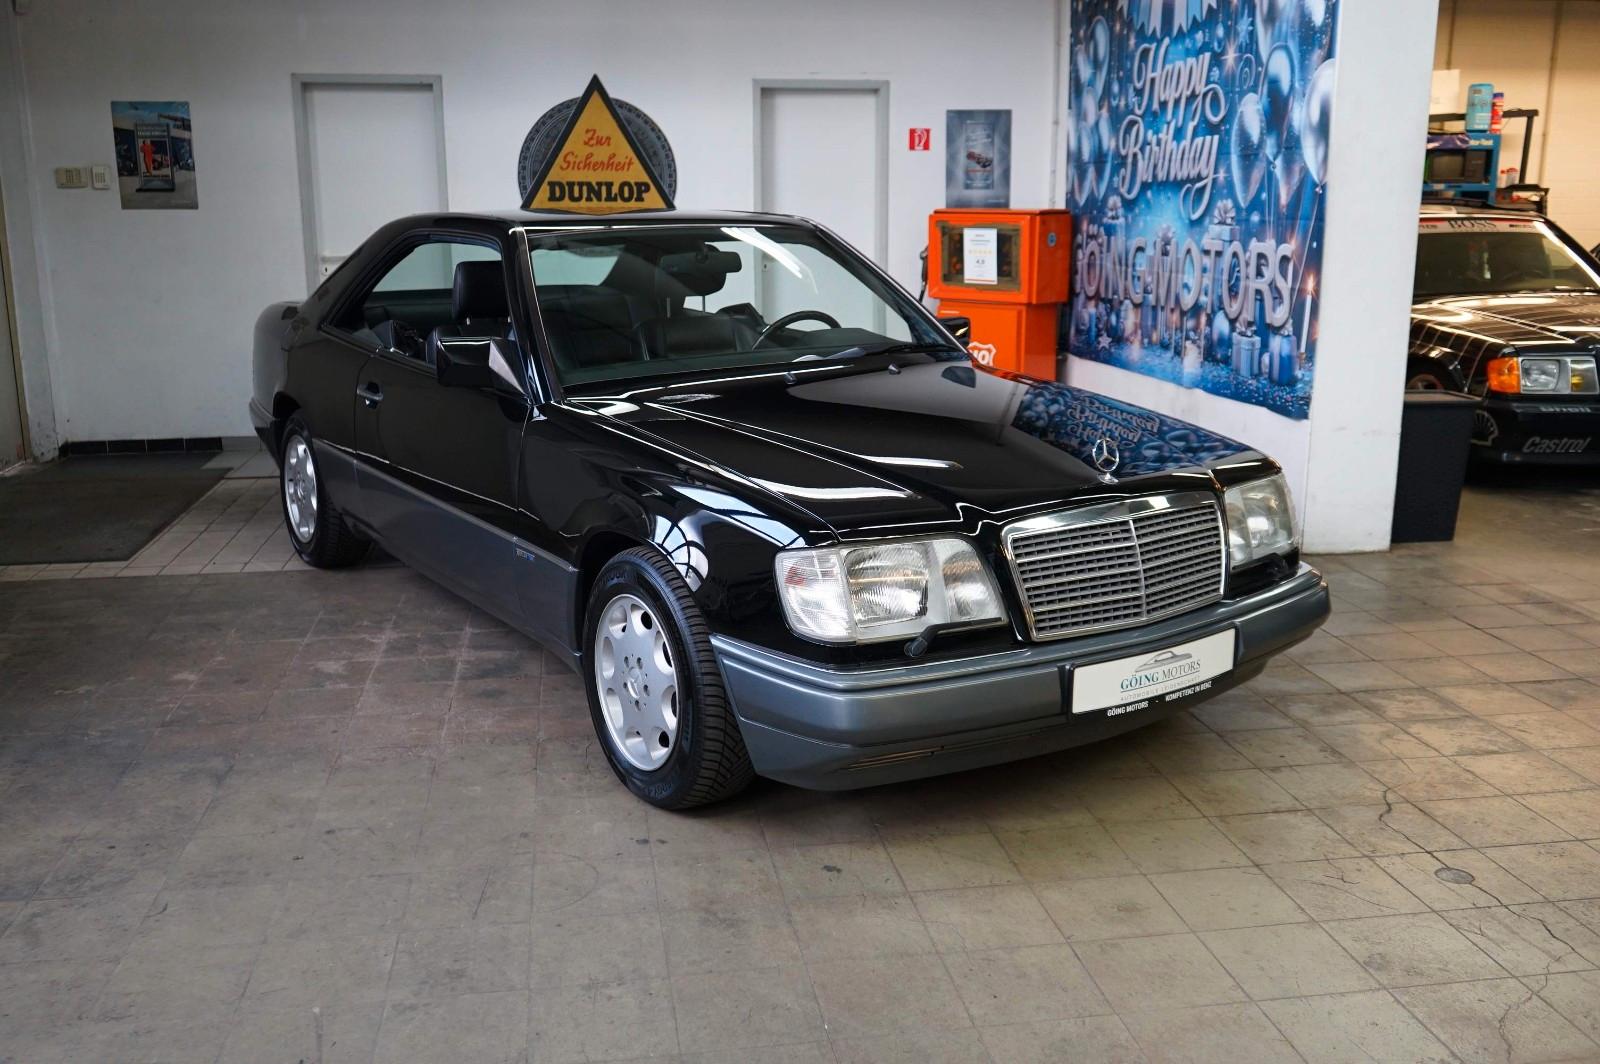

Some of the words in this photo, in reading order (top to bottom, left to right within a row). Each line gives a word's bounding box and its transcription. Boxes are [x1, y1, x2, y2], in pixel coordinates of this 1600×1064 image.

[1133, 37, 1229, 130] Happy
[583, 128, 612, 147] Zur
[560, 152, 635, 172] Sicherheit
[1119, 114, 1228, 221] Birthday
[547, 180, 651, 203] DUNLOP
[1151, 237, 1297, 328] MOTORS
[1522, 436, 1592, 453] Castrol
[1120, 674, 1159, 691] GÖING
[1161, 659, 1201, 682] MOTORS
[1107, 705, 1126, 717] GÖING
[1126, 701, 1149, 713] MOTORS
